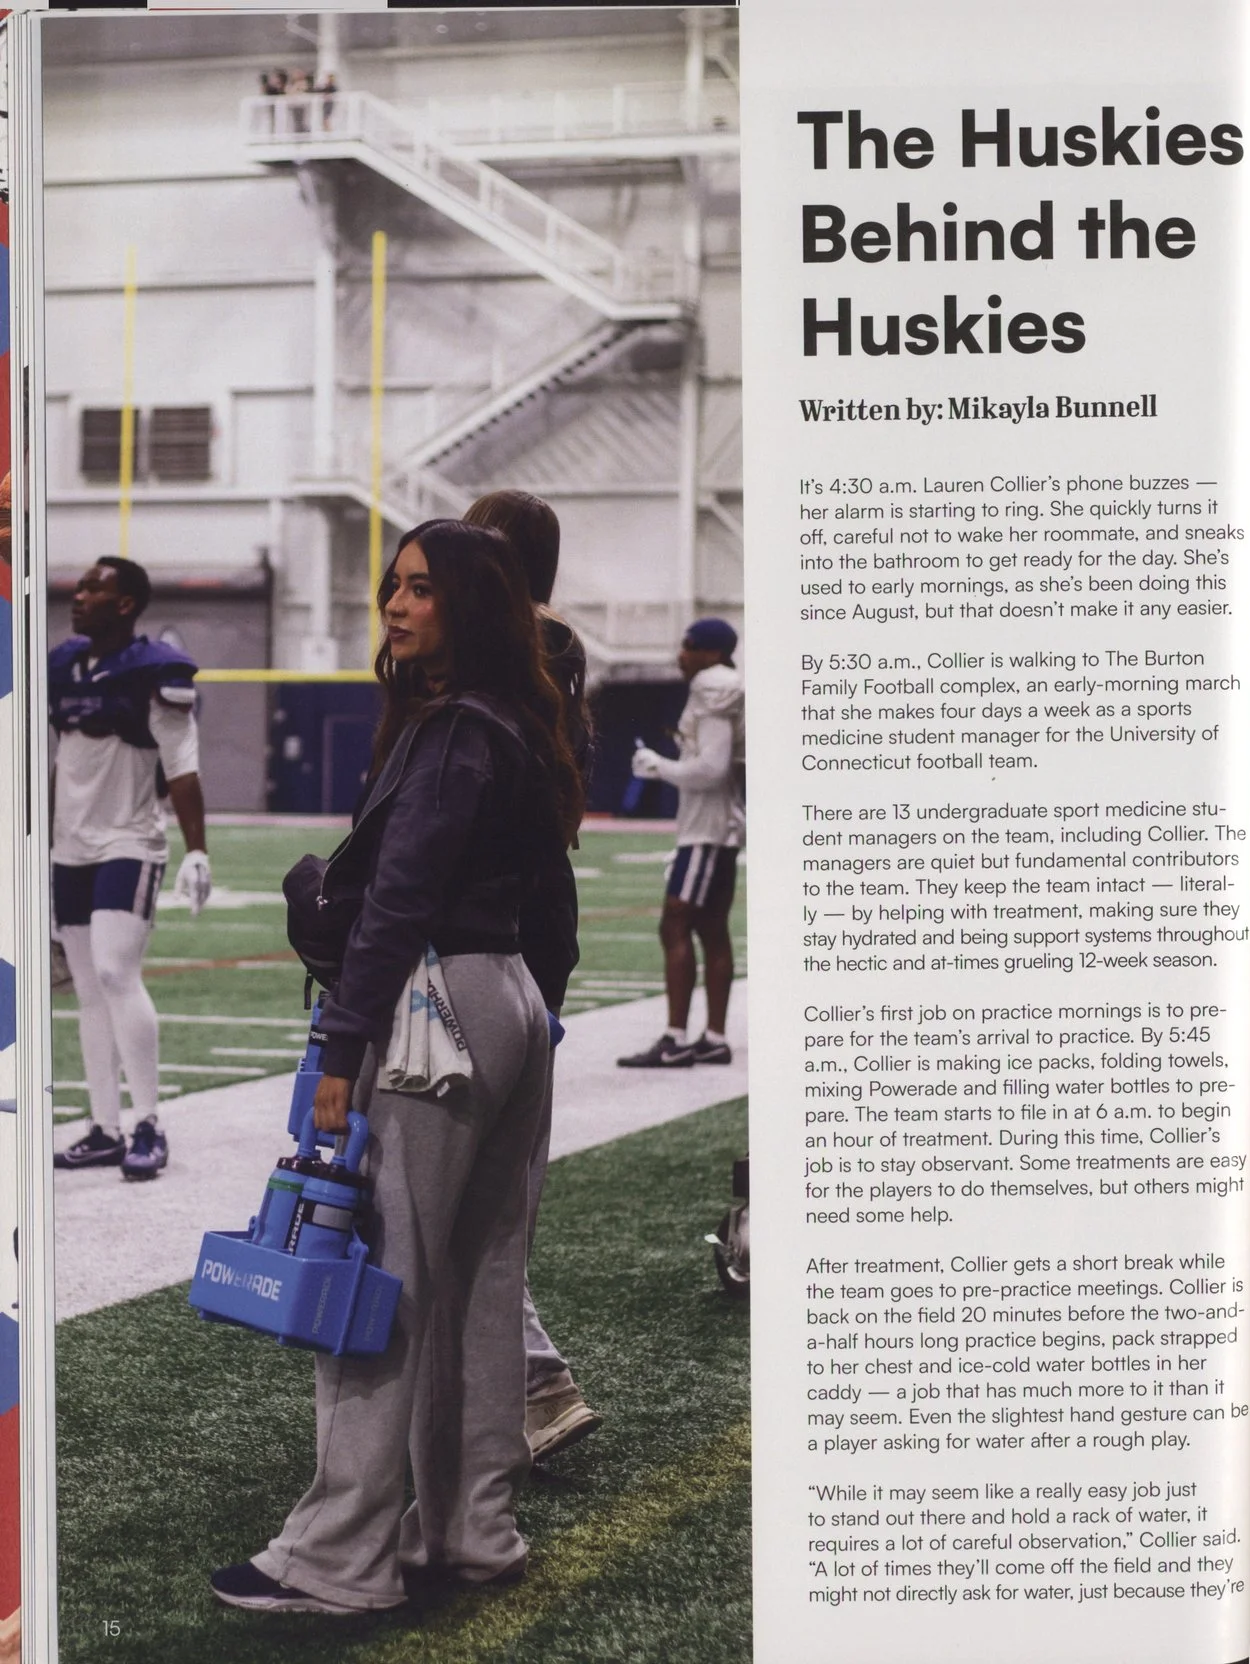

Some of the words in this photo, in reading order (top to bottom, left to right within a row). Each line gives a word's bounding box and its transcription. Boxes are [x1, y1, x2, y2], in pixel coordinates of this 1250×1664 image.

[797, 110, 934, 170] The
[962, 106, 1244, 167] Huskies
[802, 200, 1053, 263] Behind
[1078, 199, 1196, 259] the
[803, 294, 1086, 356] Huskies
[799, 399, 901, 421] Written
[905, 397, 943, 425] by:
[948, 396, 1049, 424] Mikayla
[1056, 394, 1158, 418] Bunnell
[799, 603, 847, 621] since
[851, 603, 919, 624] August,
[925, 601, 955, 619] but
[958, 601, 995, 619] that
[999, 600, 1065, 618] doesn’t
[1070, 599, 1119, 617] make
[1123, 599, 1135, 617] it
[1139, 603, 1172, 621] any
[1176, 598, 1233, 616] easier.
[801, 678, 859, 700] Family
[863, 677, 934, 696] Football
[939, 676, 1021, 698] complex,
[1026, 680, 1048, 693] an
[1053, 674, 1179, 697] early-morning
[1185, 673, 1241, 691] march
[801, 804, 853, 822] There
[858, 808, 887, 821] are
[892, 803, 911, 821] 13
[916, 801, 1049, 824] undergraduate
[1053, 802, 1100, 823] sport
[1105, 800, 1187, 818] medicine
[1191, 801, 1227, 817] stu-
[803, 1004, 875, 1023] Collier’s
[879, 1004, 914, 1022] first
[916, 1003, 947, 1026] job
[952, 1008, 976, 1021] on
[981, 1002, 1053, 1025] practice
[1058, 1001, 1142, 1023] mornings
[1147, 1001, 1161, 1019] is
[1165, 1002, 1185, 1018] to
[1189, 1004, 1228, 1022] pre-
[804, 1080, 863, 1102] mixing
[869, 1079, 958, 1097] Powerade
[963, 1078, 997, 1097] and
[1002, 1078, 1050, 1100] filling
[1055, 1079, 1105, 1095] water
[1110, 1076, 1171, 1095] bottles
[1175, 1077, 1194, 1094] to
[1199, 1080, 1236, 1097] pre-
[805, 1206, 850, 1224] need
[855, 1210, 905, 1224] some
[910, 1205, 953, 1227] help.
[805, 1257, 850, 1275] After
[853, 1257, 945, 1275] treatment,
[950, 1255, 1009, 1273] Collier
[1013, 1256, 1051, 1277] gets
[1056, 1258, 1067, 1272] a
[1072, 1253, 1119, 1272] short
[1124, 1252, 1174, 1271] break
[1178, 1252, 1226, 1270] while
[807, 1438, 818, 1452] a
[824, 1433, 879, 1456] player
[883, 1432, 940, 1455] asking
[945, 1432, 972, 1450] for
[975, 1433, 1026, 1450] water
[1030, 1431, 1072, 1449] after
[1076, 1435, 1087, 1448] a
[1092, 1430, 1145, 1452] rough
[1151, 1429, 1191, 1451] play.
[808, 1484, 868, 1502] “While
[872, 1484, 884, 1501] it
[889, 1488, 927, 1505] may
[931, 1487, 979, 1501] seem
[985, 1482, 1015, 1500] like
[1019, 1486, 1031, 1500] a
[1036, 1481, 1083, 1503] really
[1087, 1485, 1128, 1503] easy
[1130, 1480, 1161, 1503] job
[1164, 1480, 1198, 1502] just
[102, 1620, 120, 1636] 15
